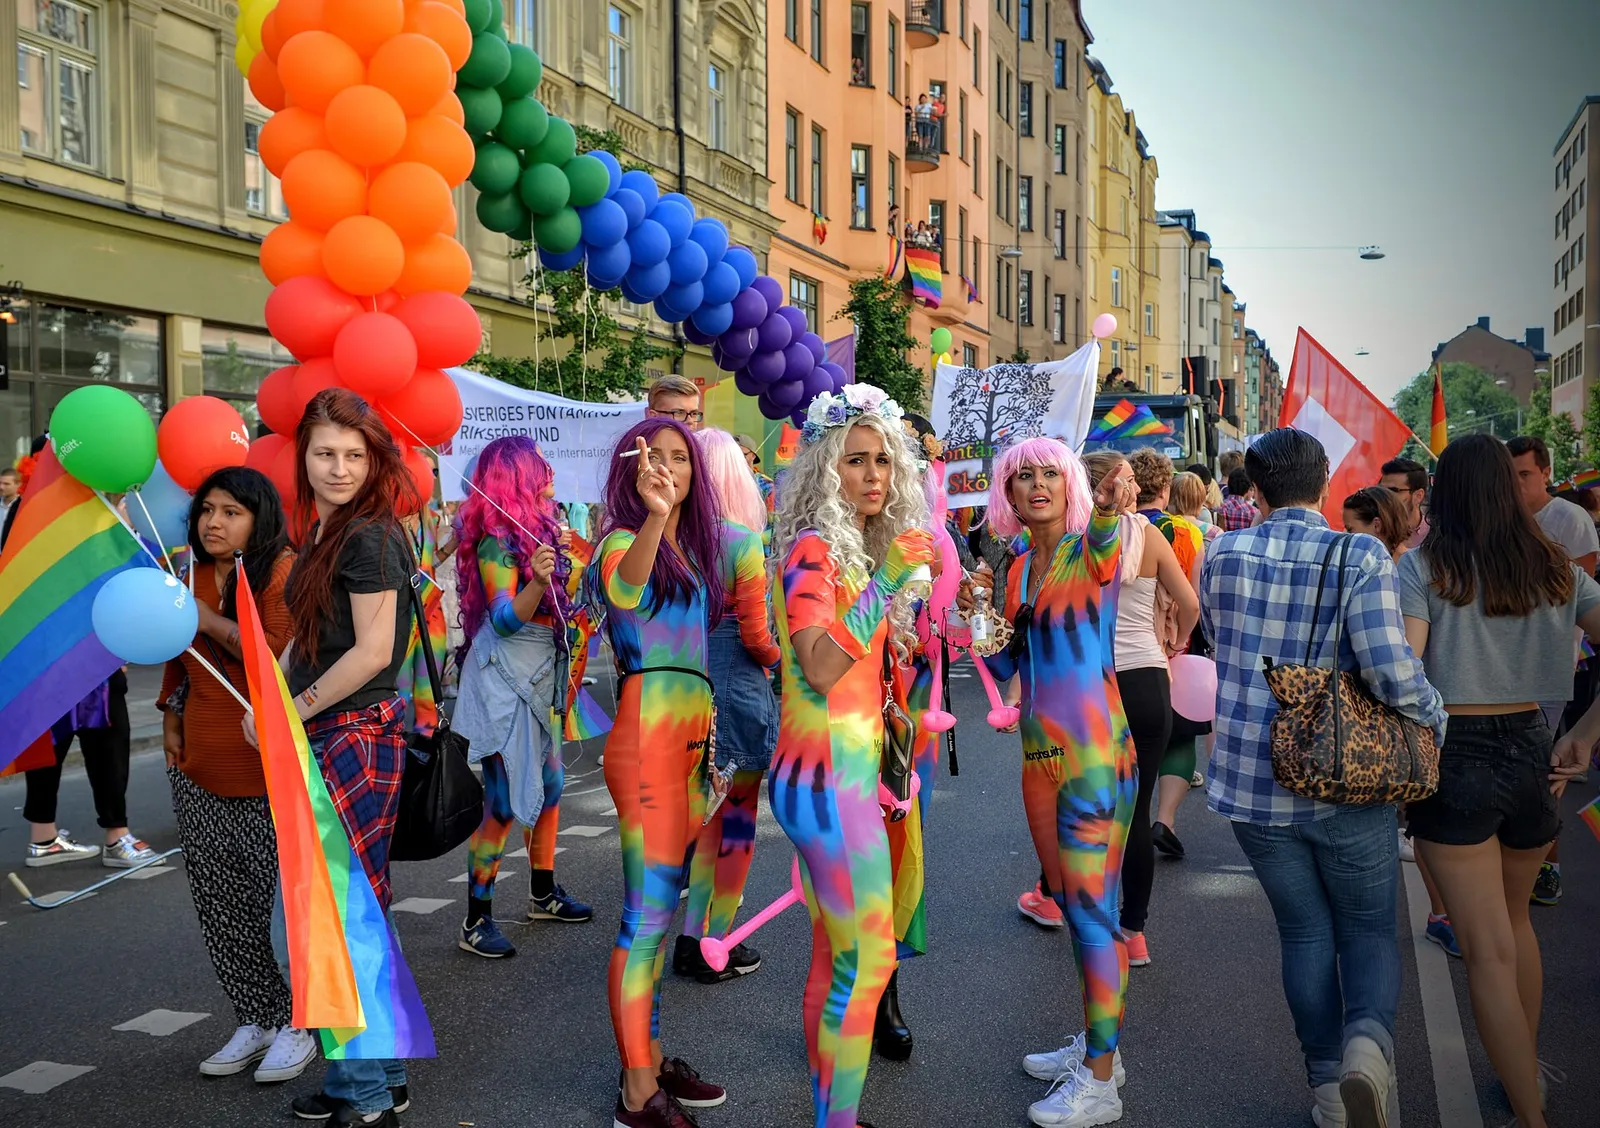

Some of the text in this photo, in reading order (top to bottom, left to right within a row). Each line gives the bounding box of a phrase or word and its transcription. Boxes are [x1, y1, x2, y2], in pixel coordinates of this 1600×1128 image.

[463, 405, 524, 421] SVERIGES
[557, 447, 614, 459] Internation
[948, 471, 990, 495] Skö
